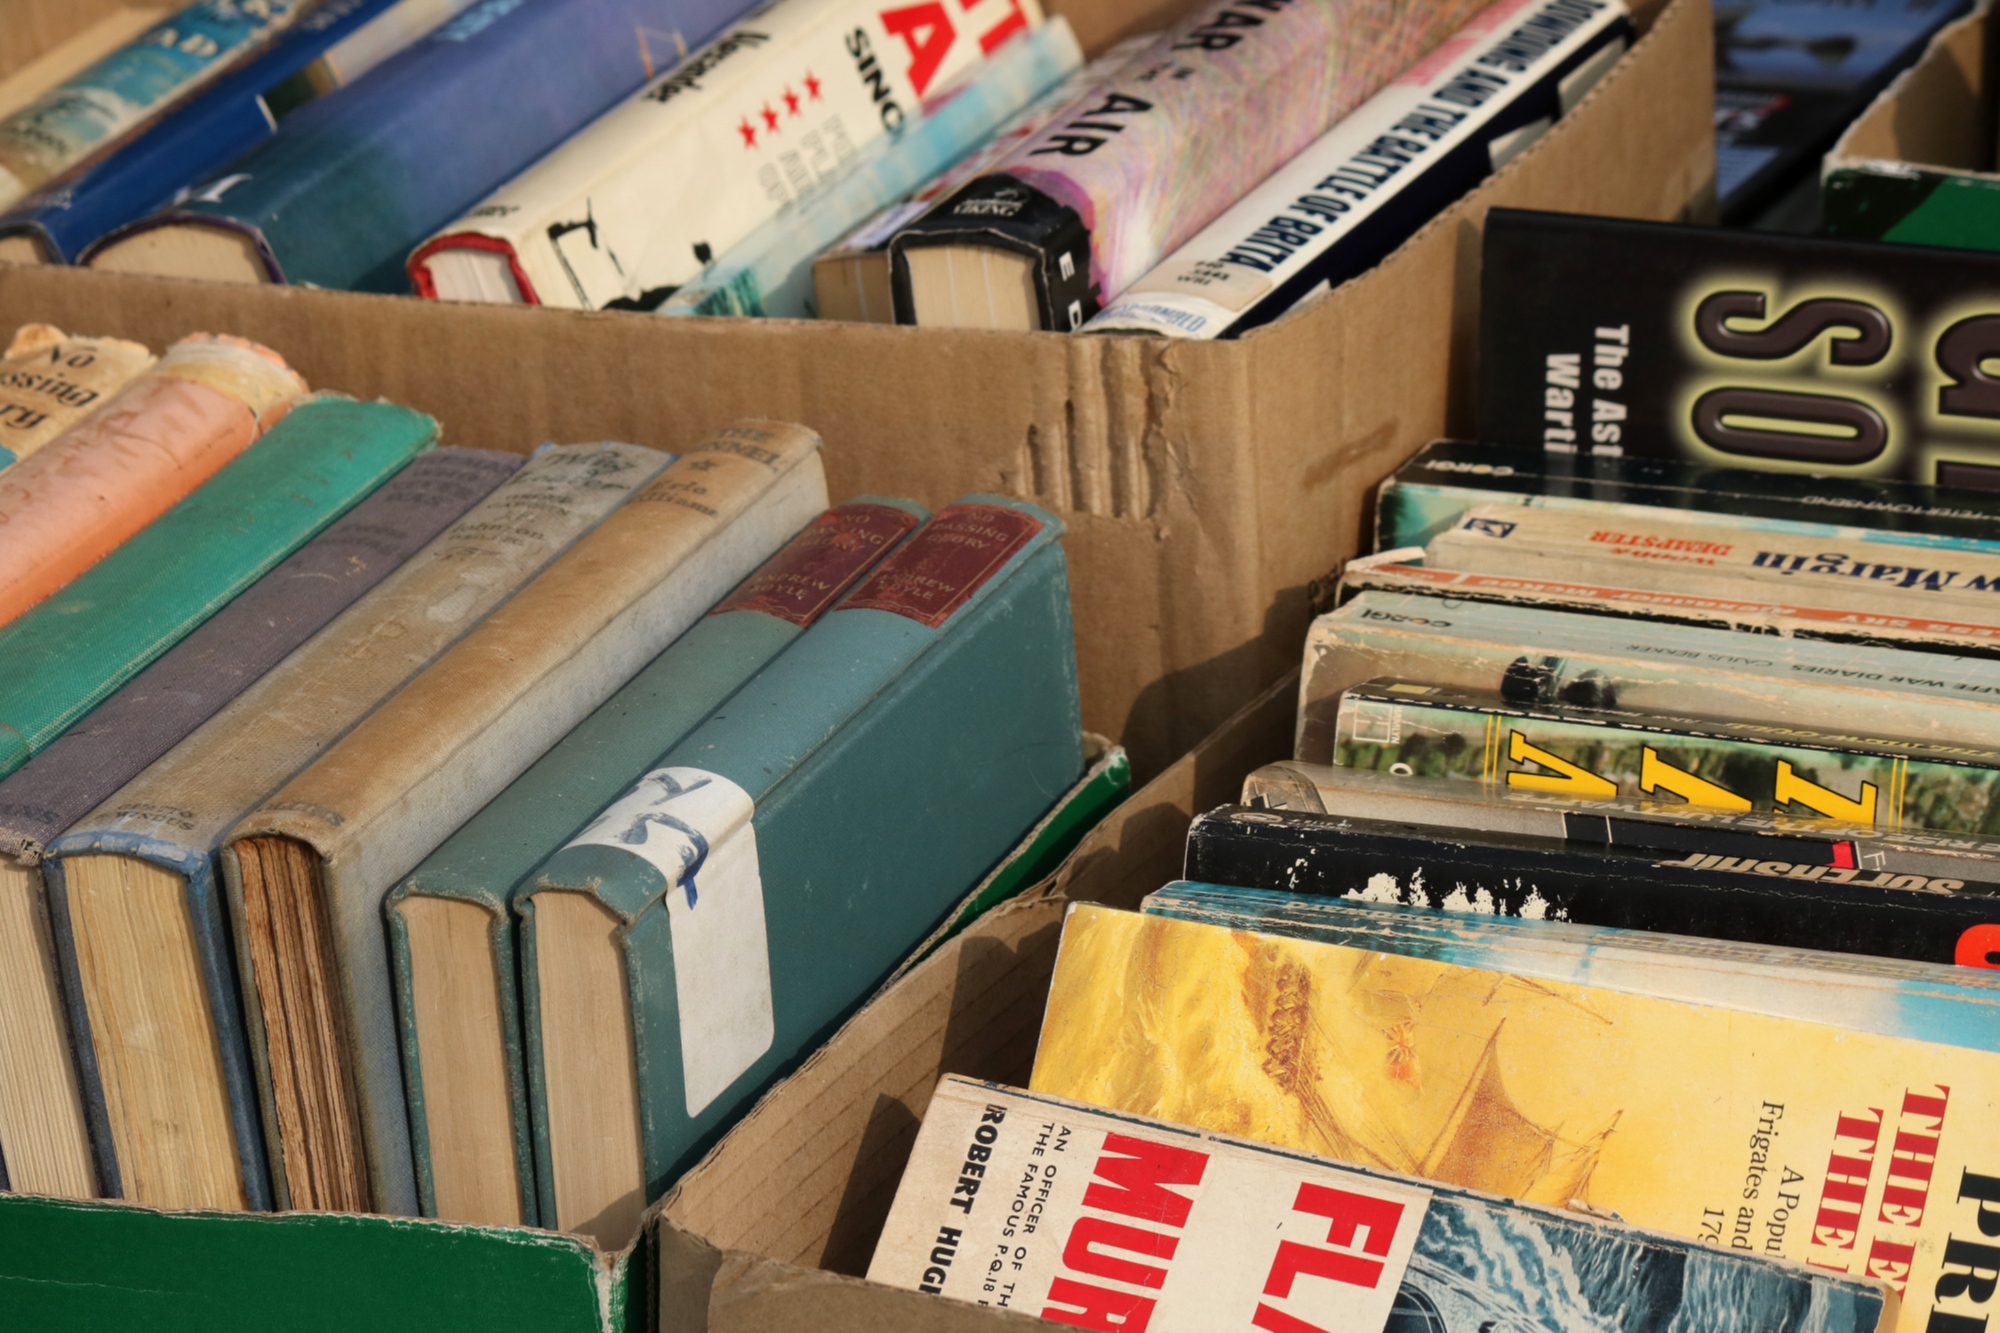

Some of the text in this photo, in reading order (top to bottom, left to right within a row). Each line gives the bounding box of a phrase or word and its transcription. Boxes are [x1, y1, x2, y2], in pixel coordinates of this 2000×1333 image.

[1030, 91, 1155, 157] AIR
[1390, 103, 1469, 142] THE
[1314, 134, 1428, 202] BATTLE
[1288, 194, 1352, 225] OF
[1592, 324, 1630, 390] The
[1424, 459, 1515, 477] CORGI
[930, 521, 1009, 543] PASSING
[967, 511, 996, 523] NO
[1589, 531, 1734, 557] DEMPSTER
[1751, 550, 1962, 592] Margin
[1360, 608, 1453, 628] CORGI
[1837, 613, 2000, 640] ESS SKY
[1790, 663, 1885, 682] DIARIES
[1888, 675, 1947, 691] WAR
[1502, 793, 1735, 827] LUFTWAFFE
[1733, 814, 1817, 833] THE
[1819, 827, 1885, 840] OF
[1883, 832, 1978, 850] RISE
[1031, 1122, 1056, 1158] THE
[1052, 1125, 1072, 1153] AN
[949, 1103, 1008, 1215] ROBERT
[1877, 1083, 1951, 1228] THE
[1730, 1099, 1786, 1252] Frigates and
[1781, 1164, 1805, 1186] A
[1810, 1106, 1885, 1251] THE
[1002, 1162, 1039, 1239] FAMOUS
[1021, 1164, 1058, 1235] OFFICER
[982, 1243, 1010, 1293] P.Q.18
[1010, 1246, 1028, 1272] OF
